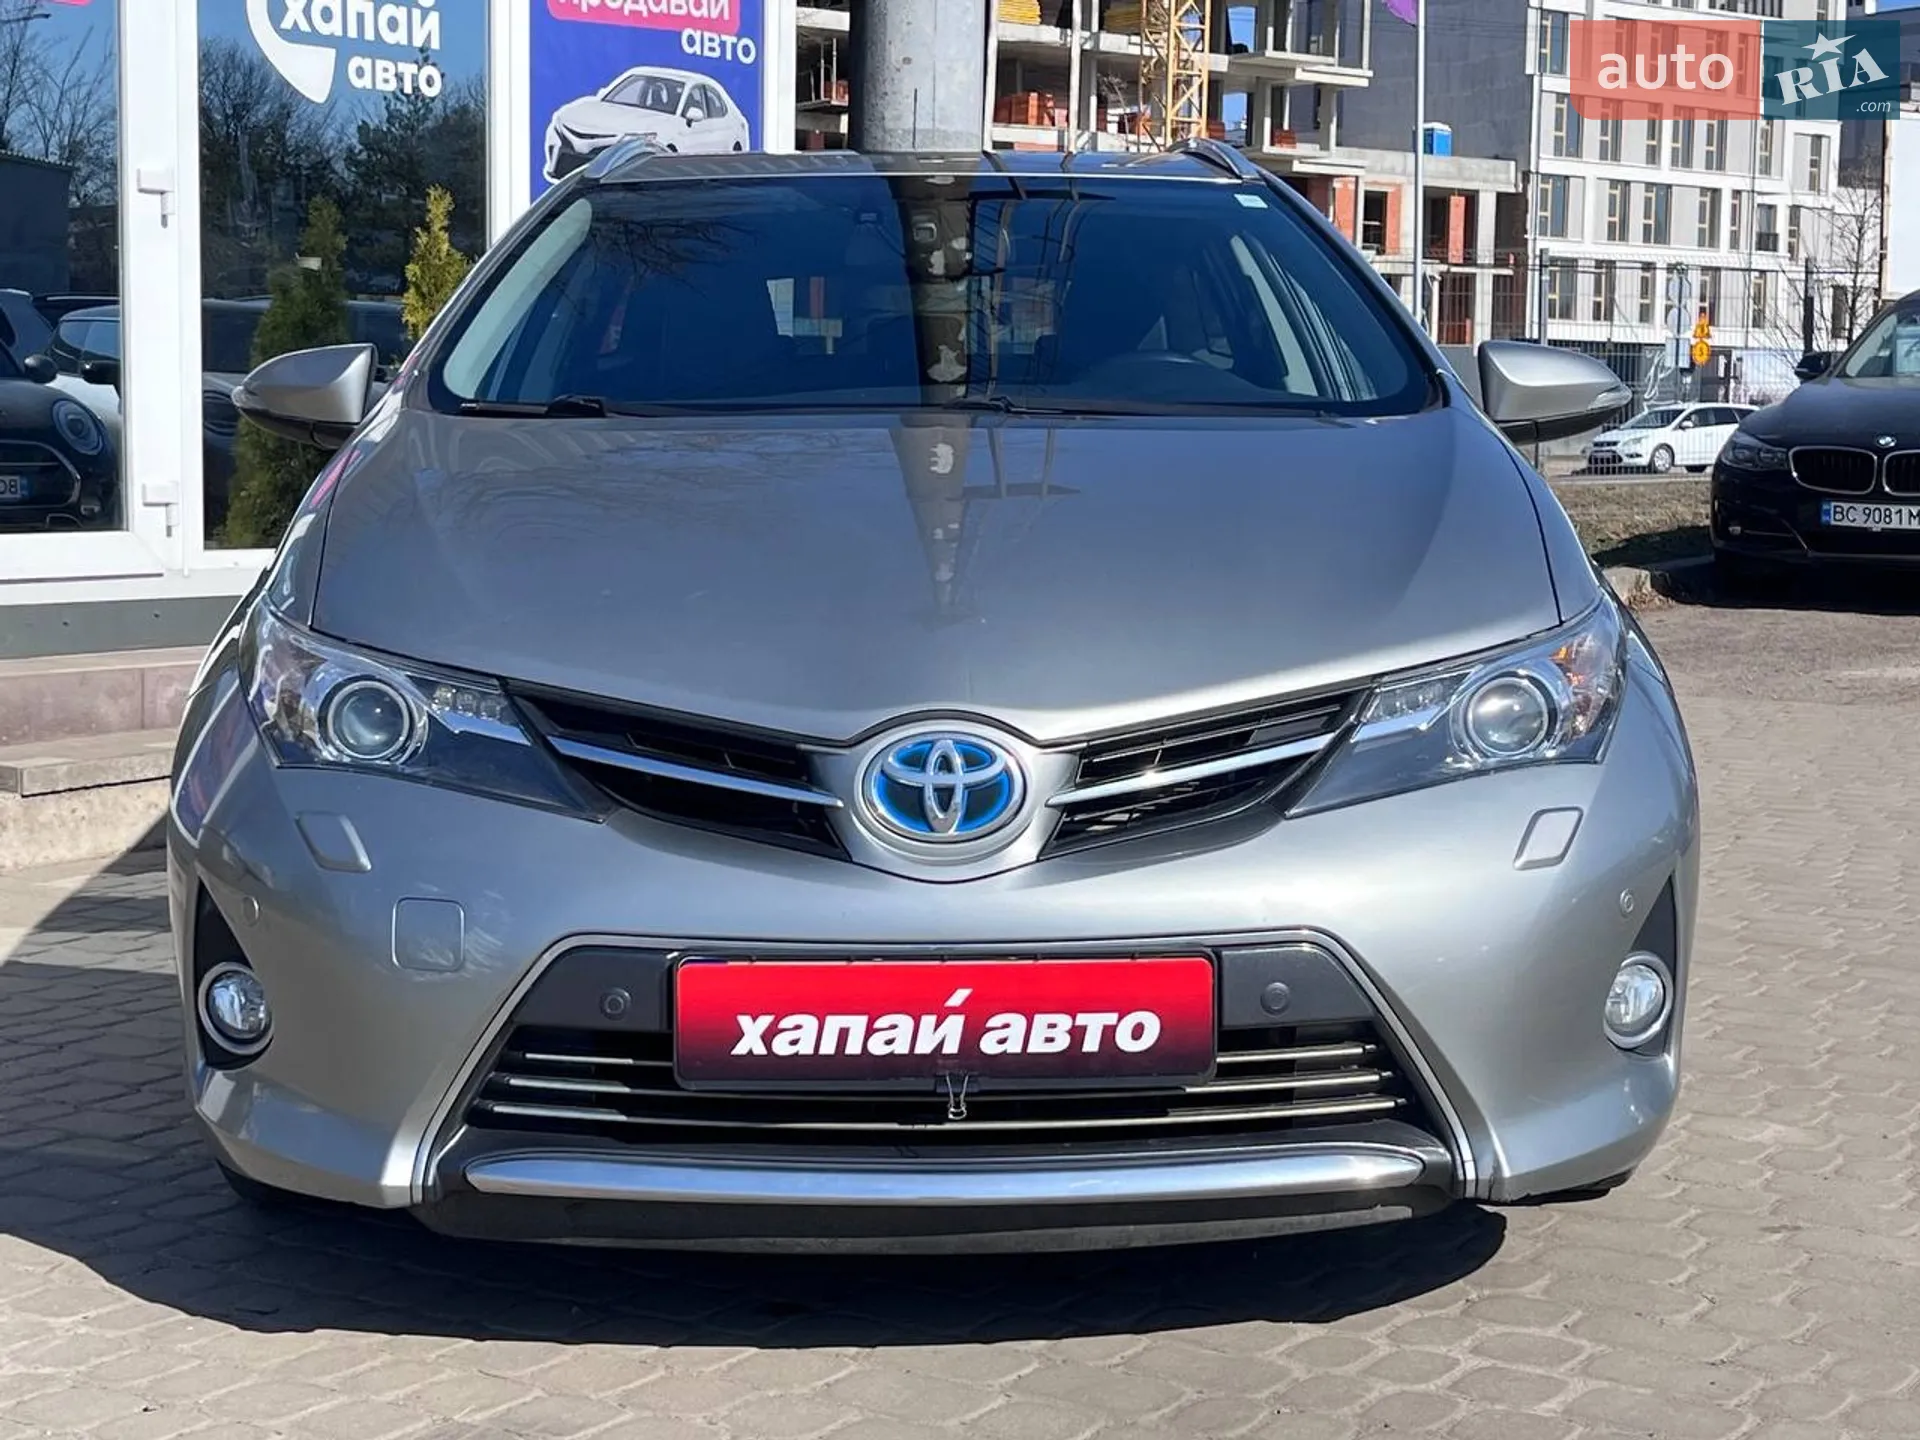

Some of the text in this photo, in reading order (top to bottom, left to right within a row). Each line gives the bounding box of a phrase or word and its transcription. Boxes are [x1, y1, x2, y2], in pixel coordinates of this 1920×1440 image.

[282, 0, 440, 50] хапай
[681, 27, 756, 65] авто
[347, 56, 442, 98] авто
[1833, 505, 1857, 523] BC
[1862, 506, 1903, 525] 9081
[731, 988, 1162, 1056] хапай авто
